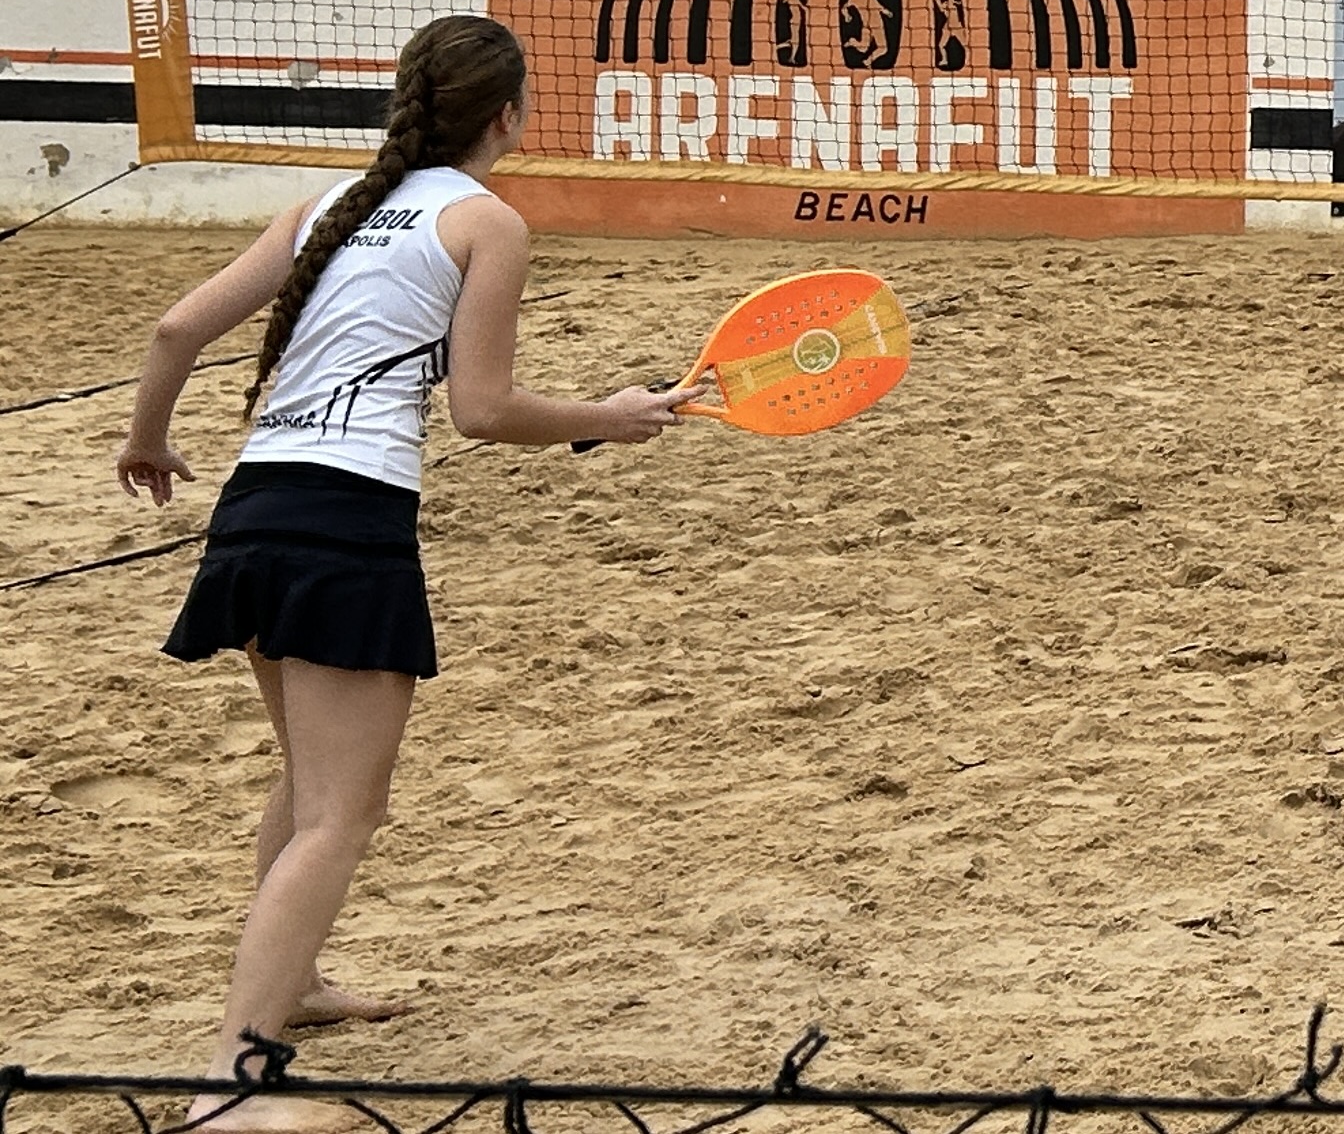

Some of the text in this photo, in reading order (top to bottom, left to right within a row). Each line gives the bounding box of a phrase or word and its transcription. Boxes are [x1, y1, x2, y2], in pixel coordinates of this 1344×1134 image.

[592, 70, 1132, 178] ARENAFUT
[367, 208, 424, 230] IBOL
[793, 191, 930, 225] BEACH
